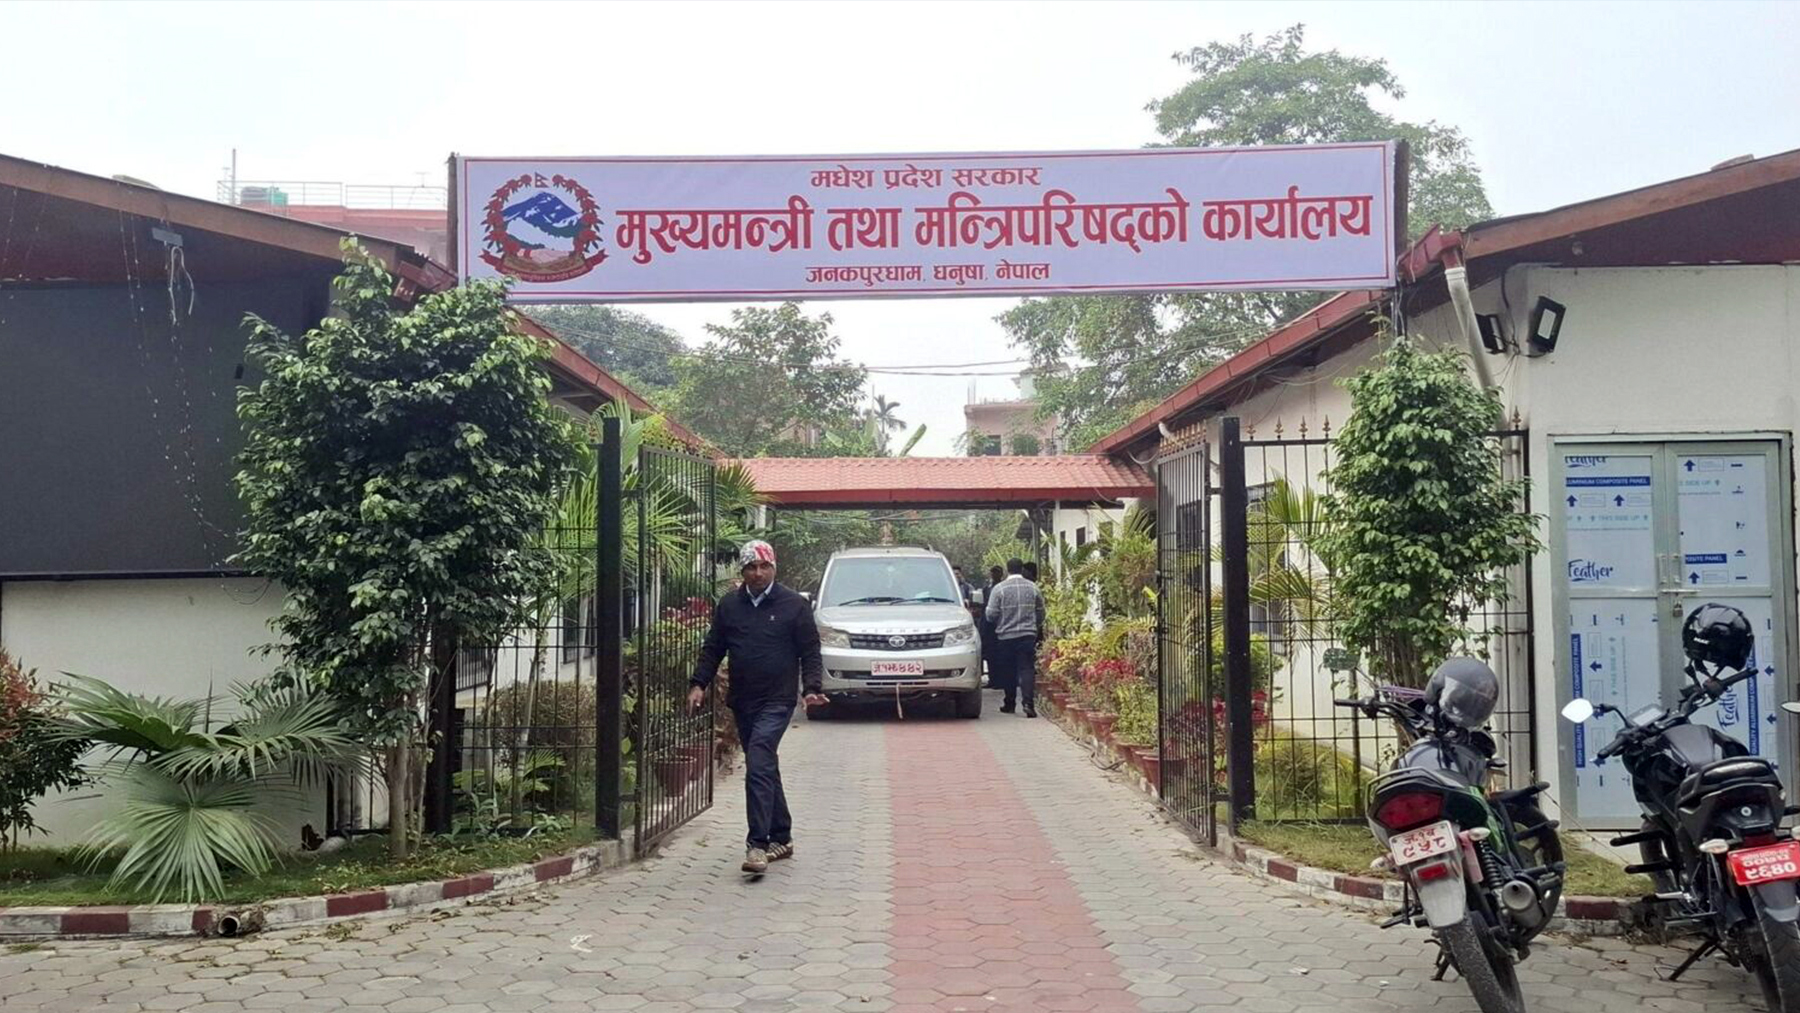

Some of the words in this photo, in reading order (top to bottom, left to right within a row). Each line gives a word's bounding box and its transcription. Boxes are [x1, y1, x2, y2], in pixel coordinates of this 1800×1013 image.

[811, 165, 875, 188] मधेश
[884, 164, 943, 189] प्रदेश
[952, 167, 1043, 187] सरकार
[615, 195, 814, 264] मुख्यमन्त्री
[827, 207, 902, 251] तथा
[915, 187, 1190, 253] मन्त्रिपरिषद्को
[1203, 186, 1374, 241] कार्यालय
[996, 259, 1051, 279] नेपाल
[1568, 559, 1613, 581] Feather
[1717, 685, 1738, 732] Feathe
